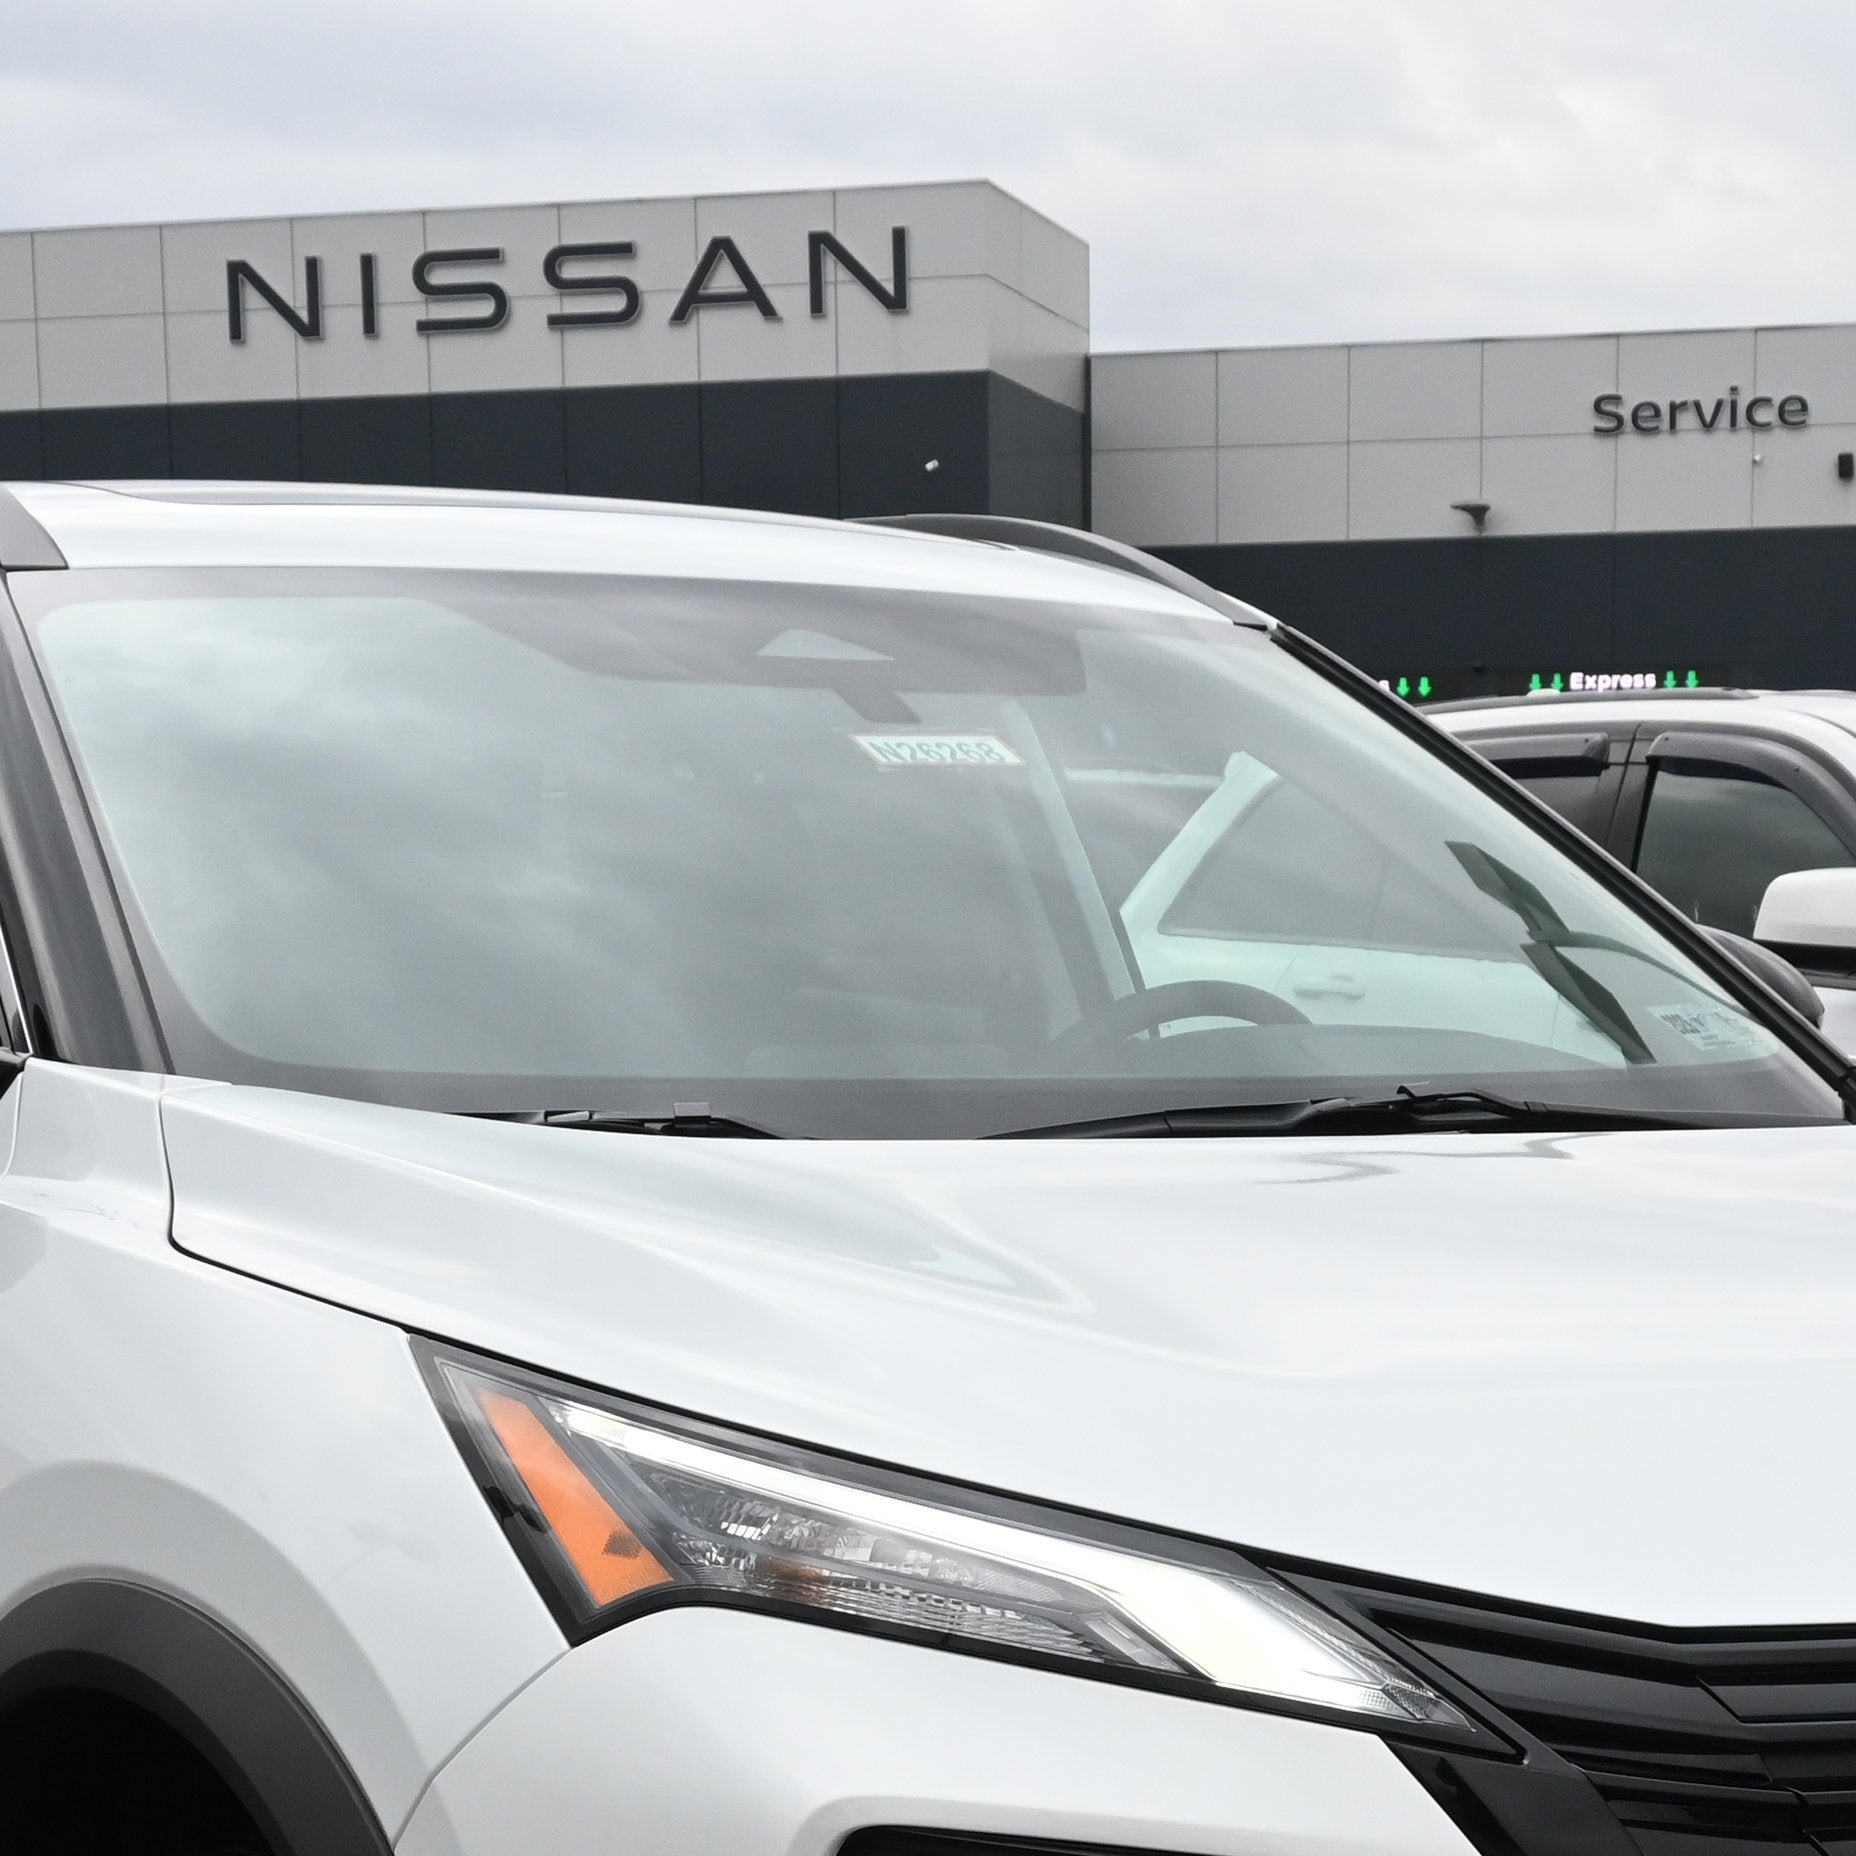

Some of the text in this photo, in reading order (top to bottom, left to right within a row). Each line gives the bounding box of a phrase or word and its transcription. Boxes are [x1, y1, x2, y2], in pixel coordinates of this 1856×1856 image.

[227, 225, 909, 342] NISSAN
[1592, 385, 1810, 435] Service
[1569, 671, 1657, 693] Express
